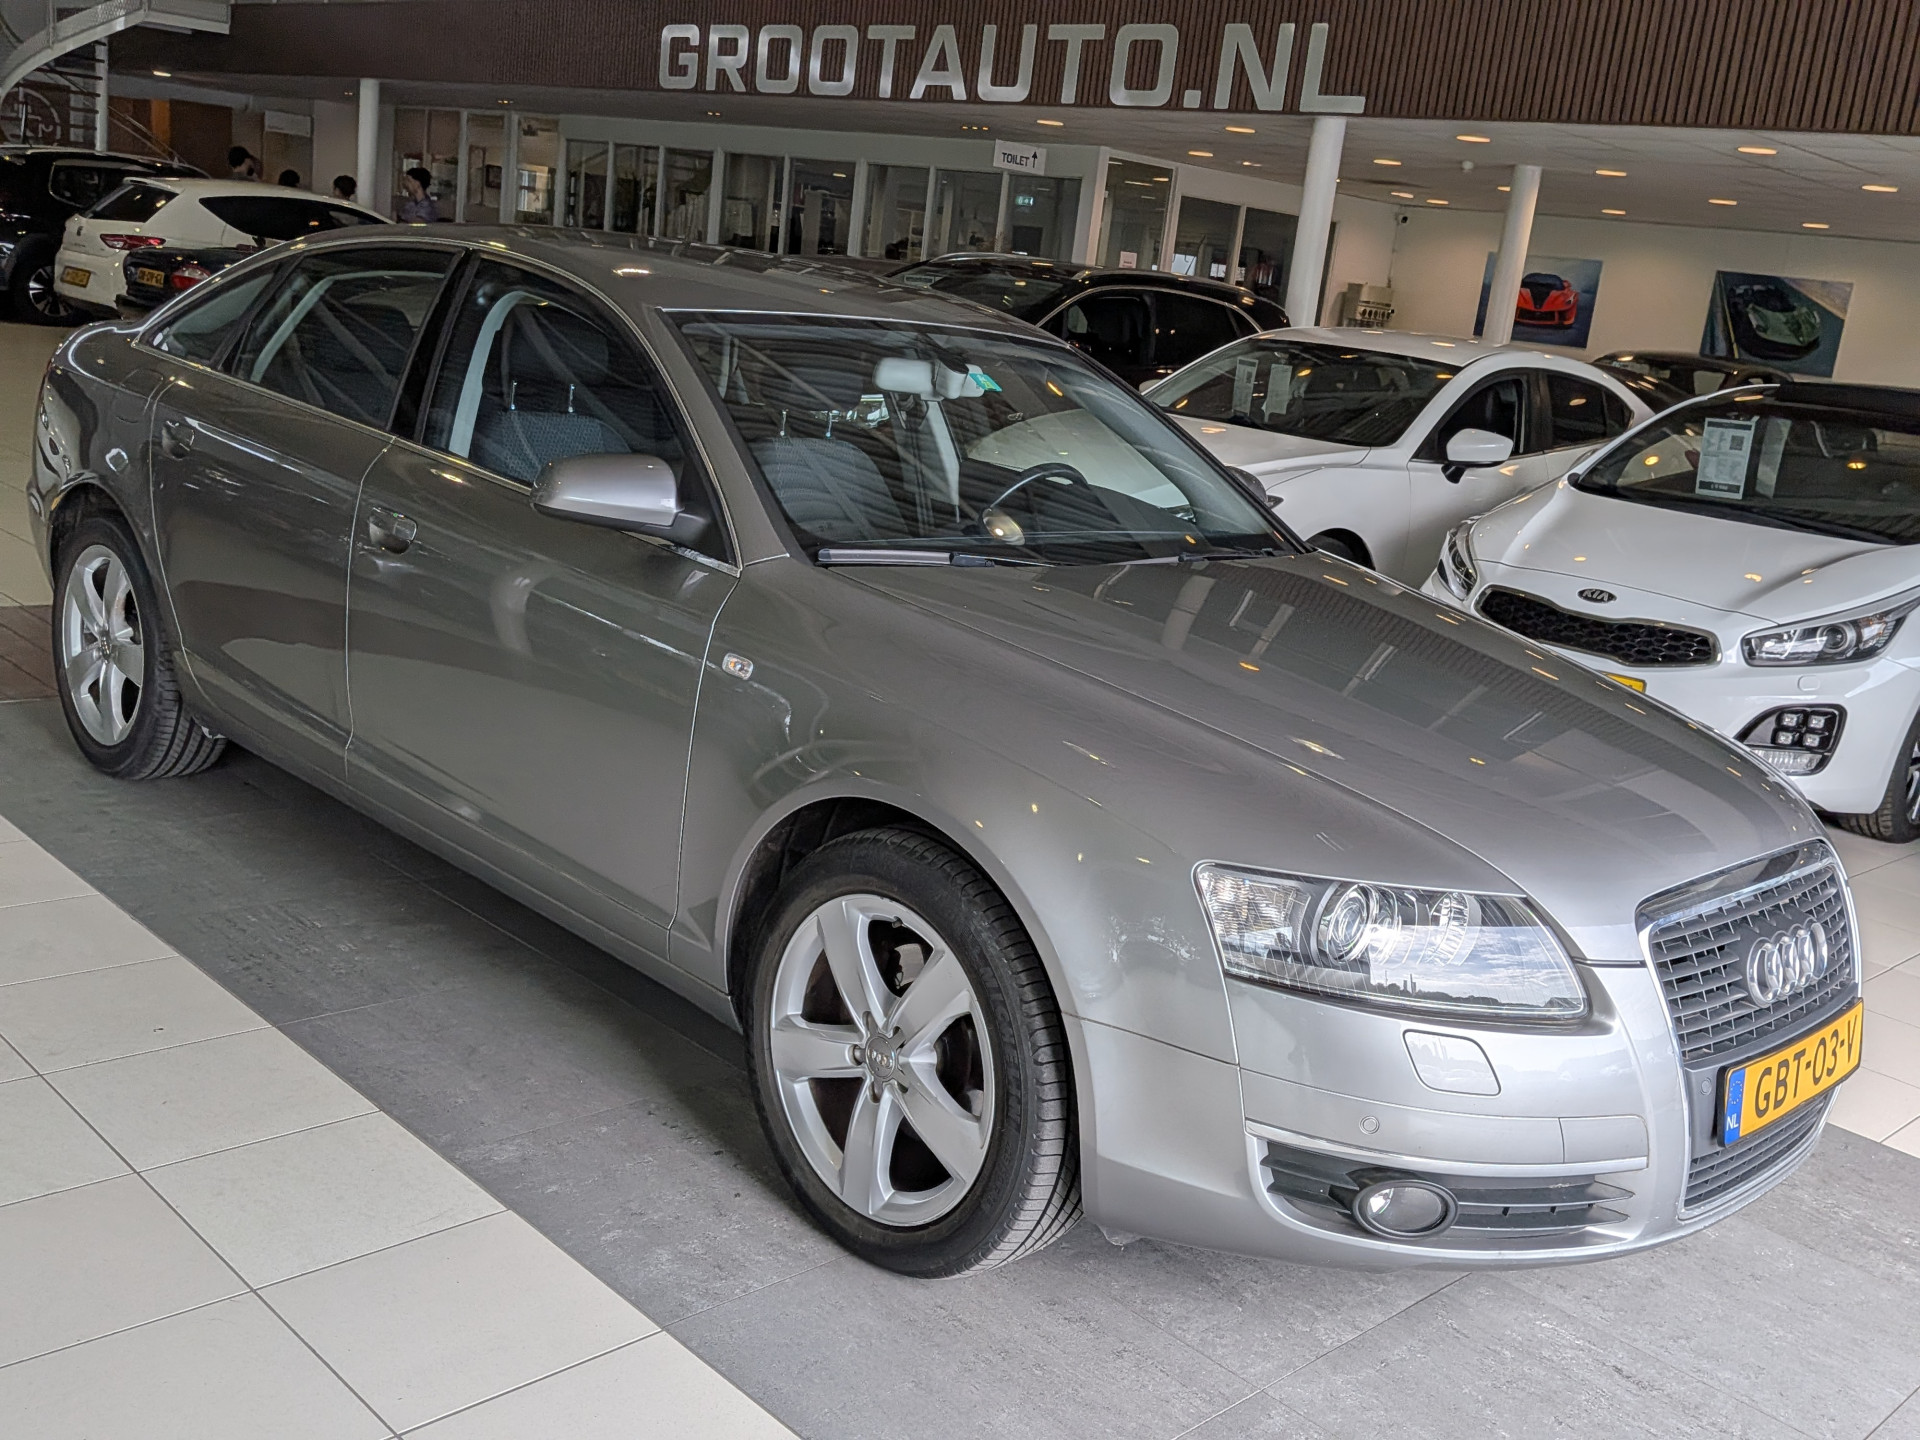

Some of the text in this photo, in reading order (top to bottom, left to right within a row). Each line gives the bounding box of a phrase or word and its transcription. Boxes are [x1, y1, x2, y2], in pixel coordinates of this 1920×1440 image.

[658, 22, 1366, 113] GROOTAUTO.NL
[1001, 151, 1030, 167] TOILET
[1582, 588, 1609, 602] KIA
[1754, 1014, 1858, 1119] GBT-03-V
[1726, 1113, 1739, 1132] NL
